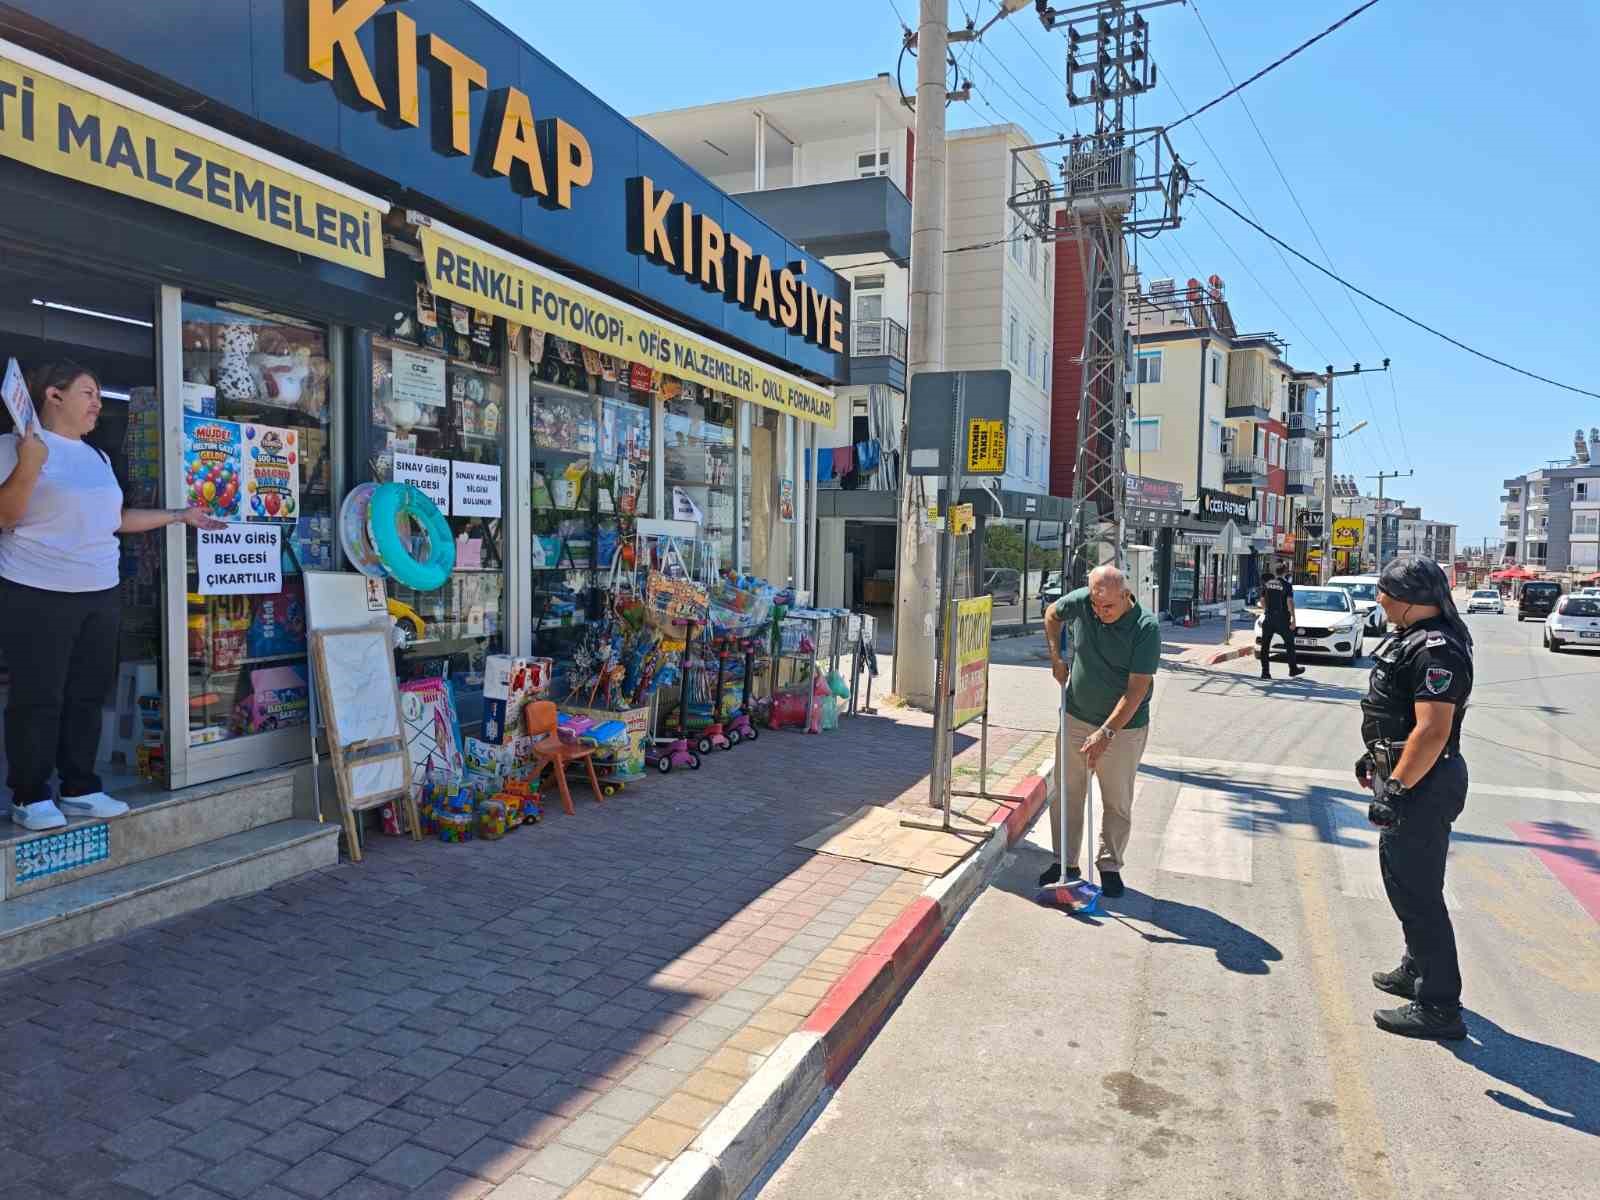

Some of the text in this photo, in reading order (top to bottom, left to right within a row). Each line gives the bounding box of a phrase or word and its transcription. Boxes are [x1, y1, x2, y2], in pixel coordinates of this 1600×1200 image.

[58, 102, 372, 257] MALZEMELERİ
[642, 175, 843, 353] KIRTASİYE
[435, 246, 523, 310] RENKLİ
[531, 285, 624, 346] FOTOKOPİ
[638, 328, 671, 363] OFİS
[673, 342, 753, 393] MALZEMELERİ
[761, 378, 784, 404] OKUL
[788, 388, 832, 421] FORMALARI
[395, 461, 448, 477] SINAV GİRİŞ
[455, 471, 475, 481] SINAV
[201, 531, 277, 546] SINAV GİRİŞ
[214, 550, 267, 565] BELGESİ
[206, 572, 277, 588] ÇIKARTILIR
